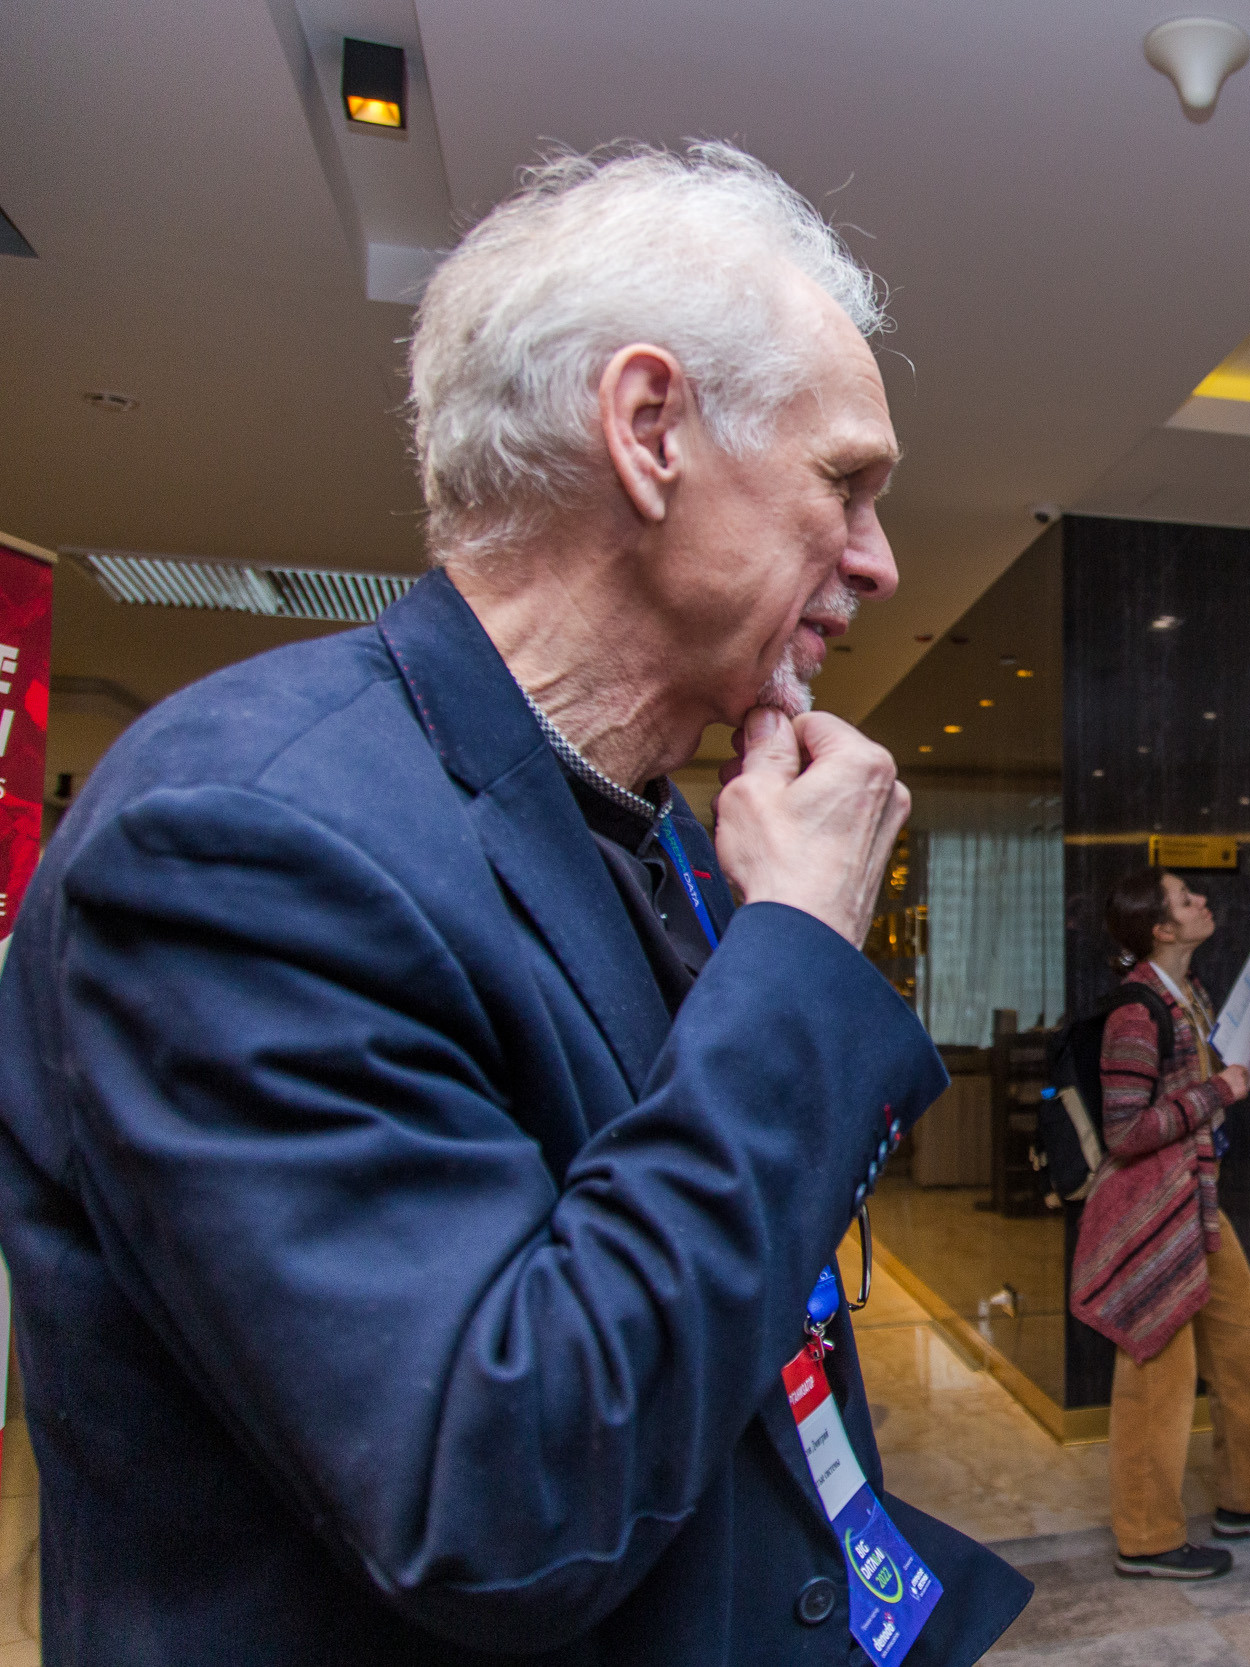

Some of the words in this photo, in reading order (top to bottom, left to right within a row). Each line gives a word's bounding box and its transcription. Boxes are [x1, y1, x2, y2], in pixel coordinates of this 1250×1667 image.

[789, 1375, 814, 1405] РГАНИЗАТОР
[855, 1539, 870, 1559] BIG
[875, 1566, 892, 1589] 2022
